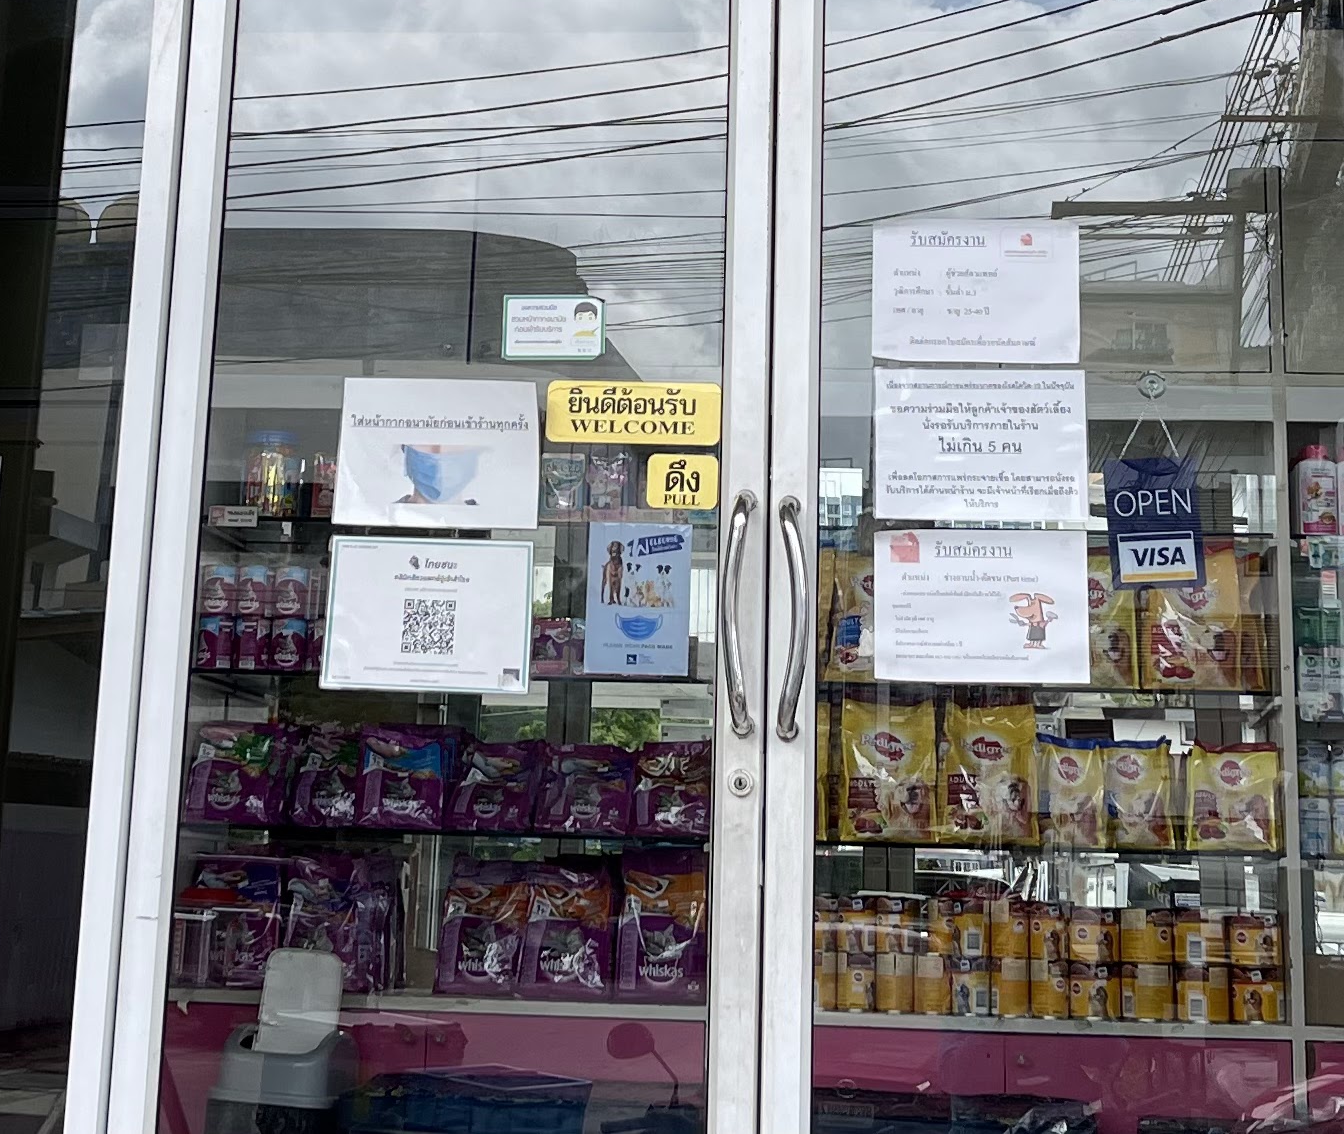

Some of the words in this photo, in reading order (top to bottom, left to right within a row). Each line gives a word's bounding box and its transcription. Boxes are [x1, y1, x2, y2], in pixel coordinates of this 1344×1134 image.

[909, 230, 987, 248] รับสมัครงาน
[568, 387, 697, 416] ยินดีต้อนรับ
[570, 418, 696, 436] WELCOME
[938, 436, 983, 454] ไม่เกิน
[987, 440, 997, 454] 5
[1002, 440, 1023, 454] คน
[665, 459, 701, 494] ดึง
[664, 494, 701, 507] PULL
[1114, 488, 1192, 517] OPEN
[934, 541, 1014, 559] รับสมัครงาน
[1128, 546, 1187, 567] VISA
